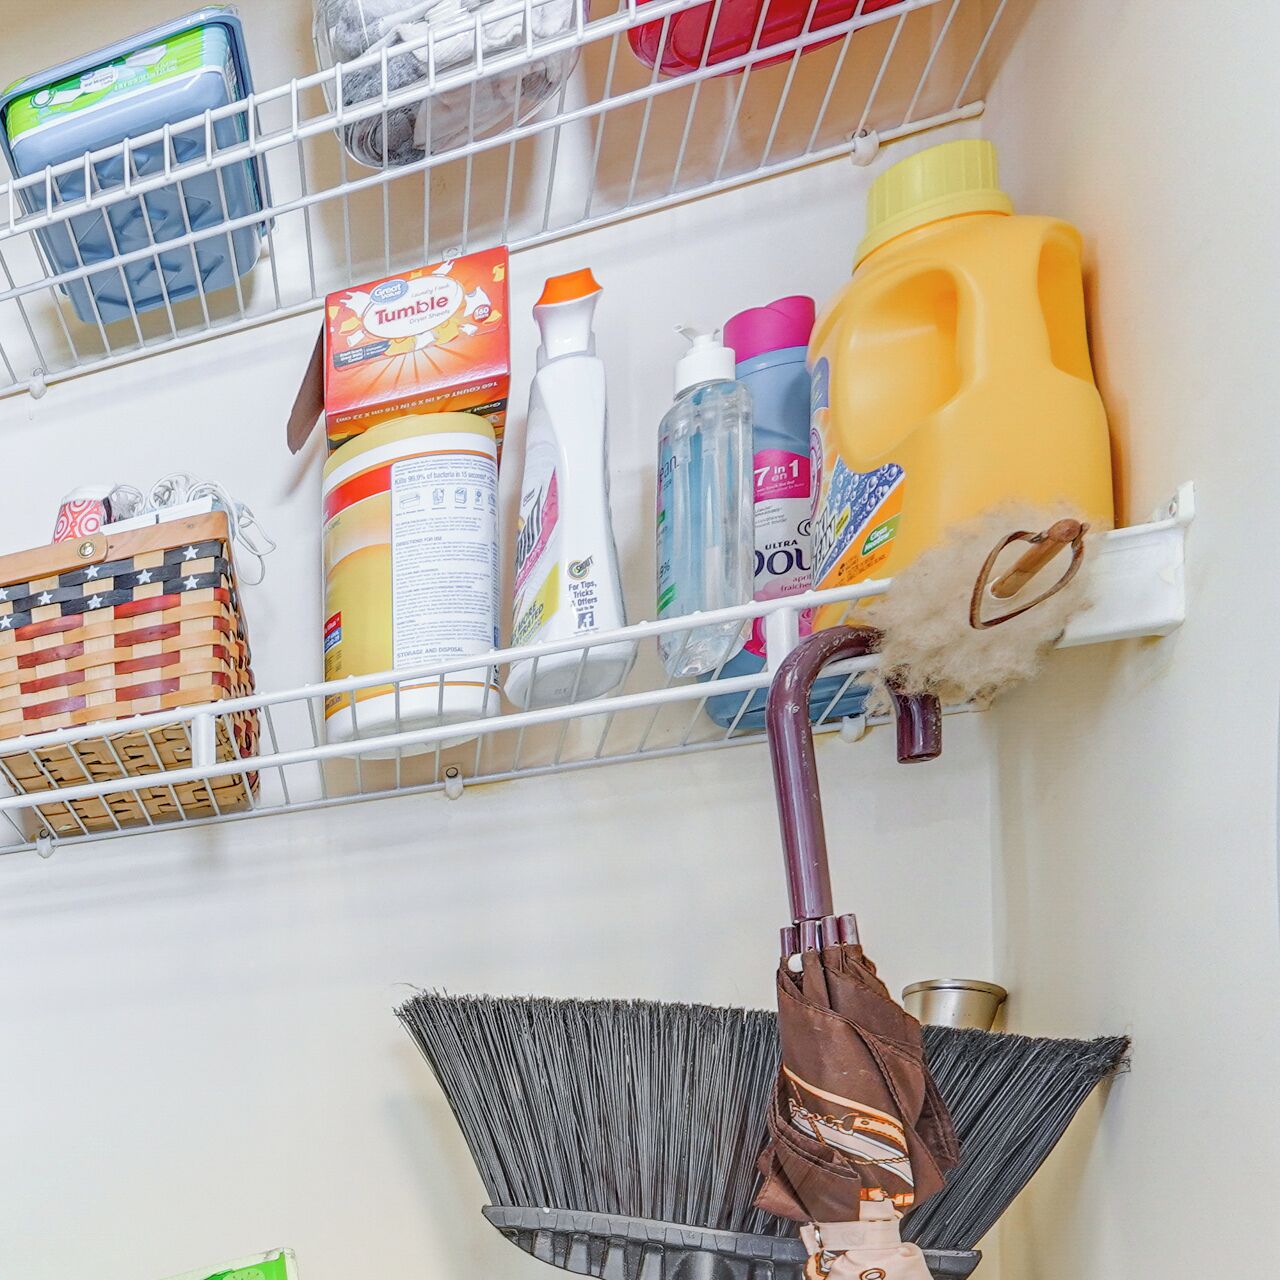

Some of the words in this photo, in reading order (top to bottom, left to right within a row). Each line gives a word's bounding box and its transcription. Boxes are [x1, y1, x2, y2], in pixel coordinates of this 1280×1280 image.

[374, 282, 402, 298] Great
[376, 296, 448, 324] Tumble
[409, 314, 428, 325] Dryer
[452, 384, 480, 396] COUNT
[754, 466, 771, 488] 7
[774, 465, 786, 474] in
[788, 459, 799, 478] 1
[764, 538, 799, 550] ULTRA
[568, 584, 580, 592] For
[580, 580, 598, 589] Tips,
[573, 589, 594, 599] Tricks
[577, 596, 598, 607] Offers
